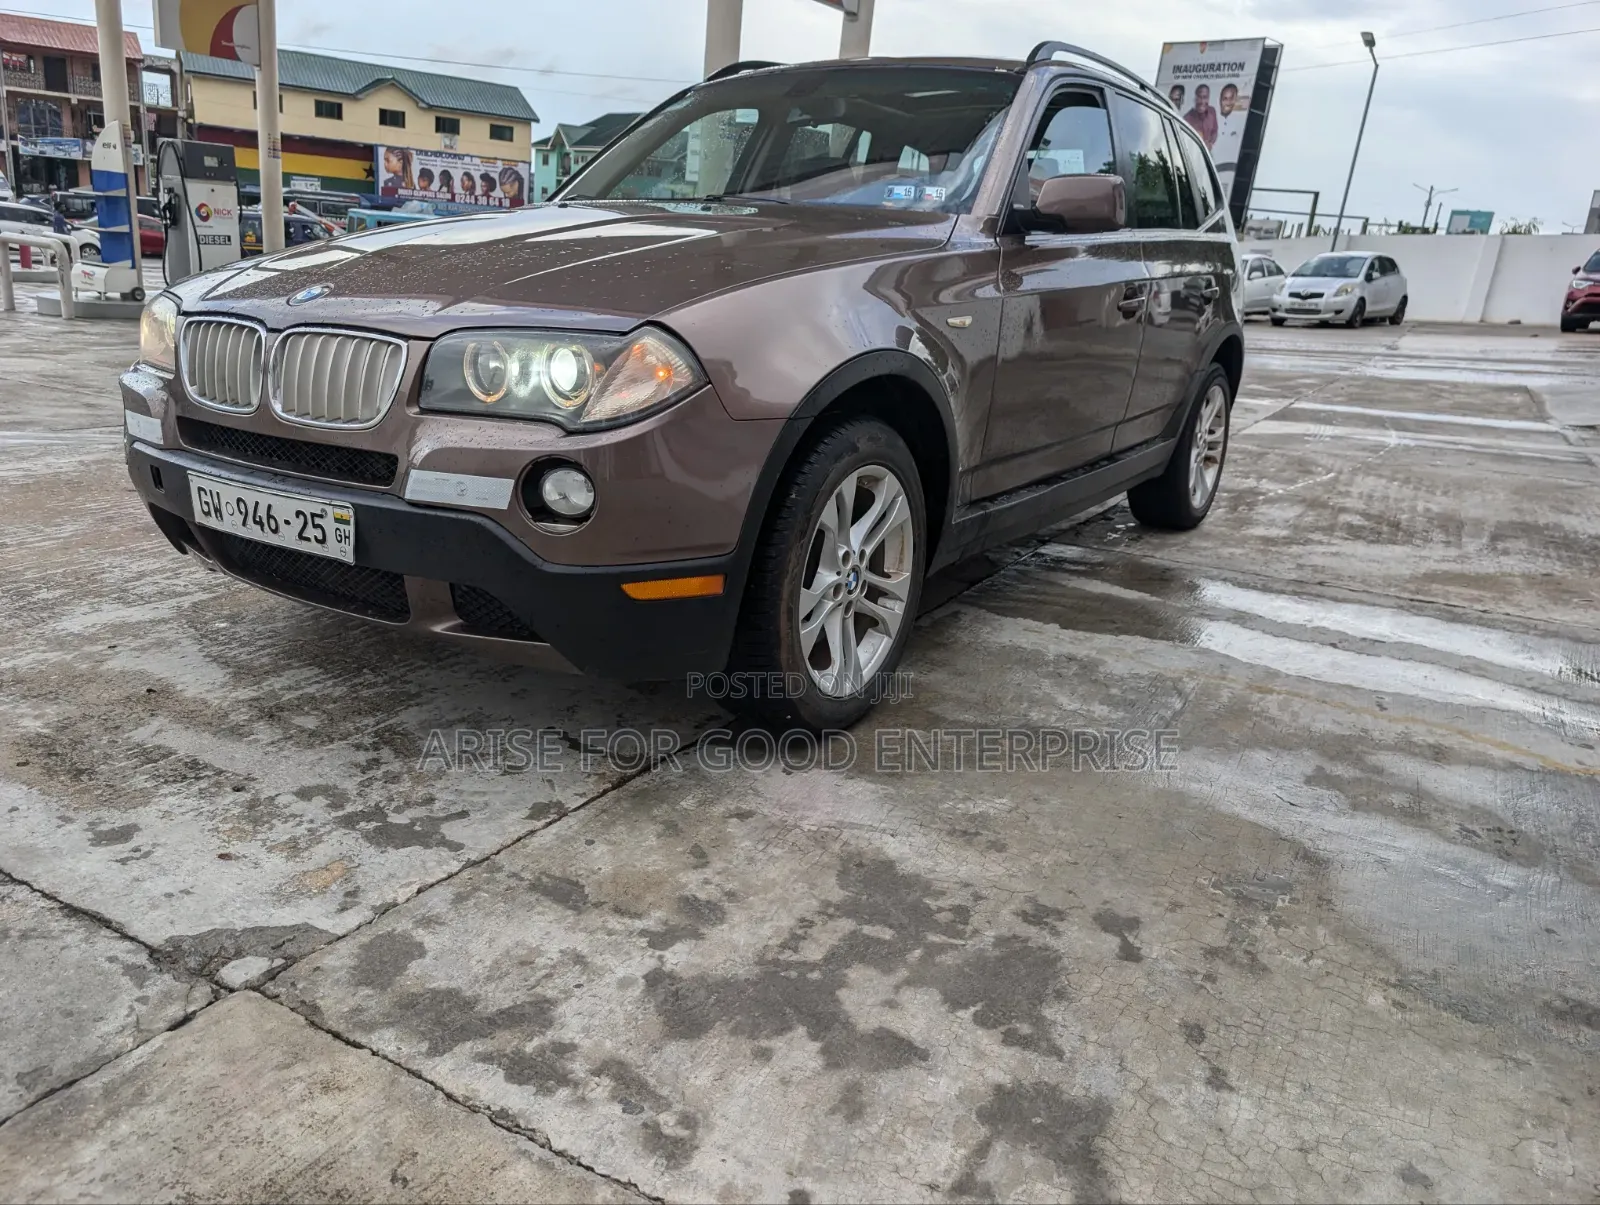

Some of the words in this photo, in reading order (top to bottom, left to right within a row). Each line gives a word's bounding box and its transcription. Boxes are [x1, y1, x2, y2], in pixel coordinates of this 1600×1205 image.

[1172, 62, 1245, 74] INAUGURATION
[904, 187, 912, 197] 16
[935, 188, 944, 199] 16
[454, 193, 475, 204] 0244
[213, 208, 233, 216] NICK
[199, 235, 231, 245] DIESEL
[334, 527, 351, 547] GH
